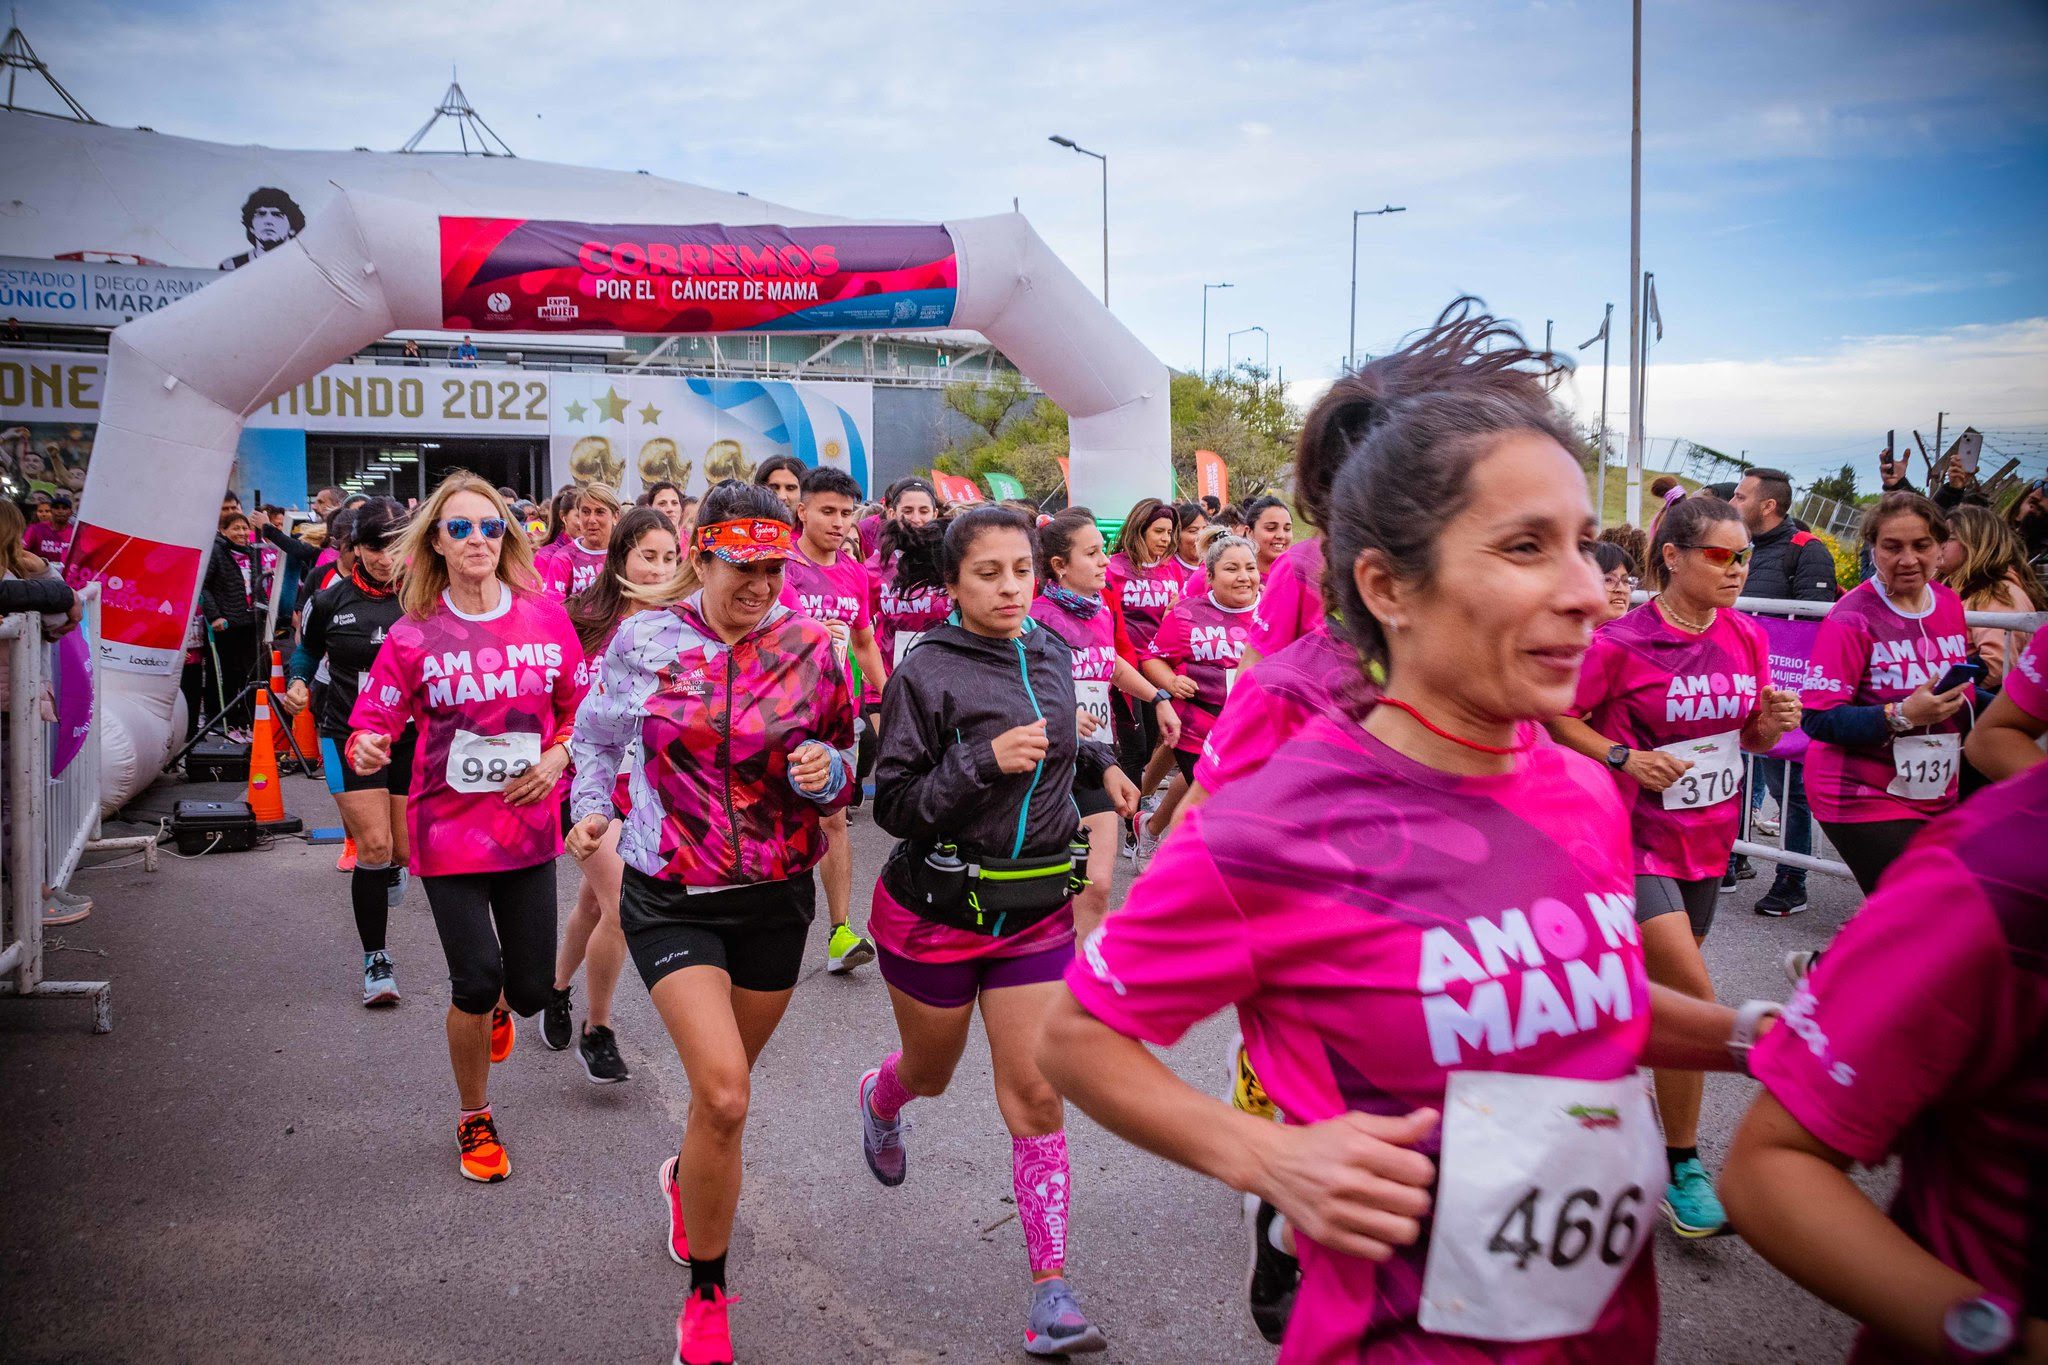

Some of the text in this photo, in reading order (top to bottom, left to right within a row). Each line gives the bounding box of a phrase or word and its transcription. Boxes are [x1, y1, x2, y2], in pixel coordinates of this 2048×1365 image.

[578, 241, 840, 277] CORREMOS
[94, 275, 149, 292] DIEGO
[596, 276, 819, 301] POR EL CÁNCER DE MAMA
[541, 307, 575, 317] MUJER
[441, 379, 549, 421] 2022
[837, 596, 860, 611] MIS
[505, 643, 562, 669] MIS
[1901, 758, 1952, 783] 1131
[1680, 767, 1735, 805] 370
[1489, 1183, 1644, 1271] 466
